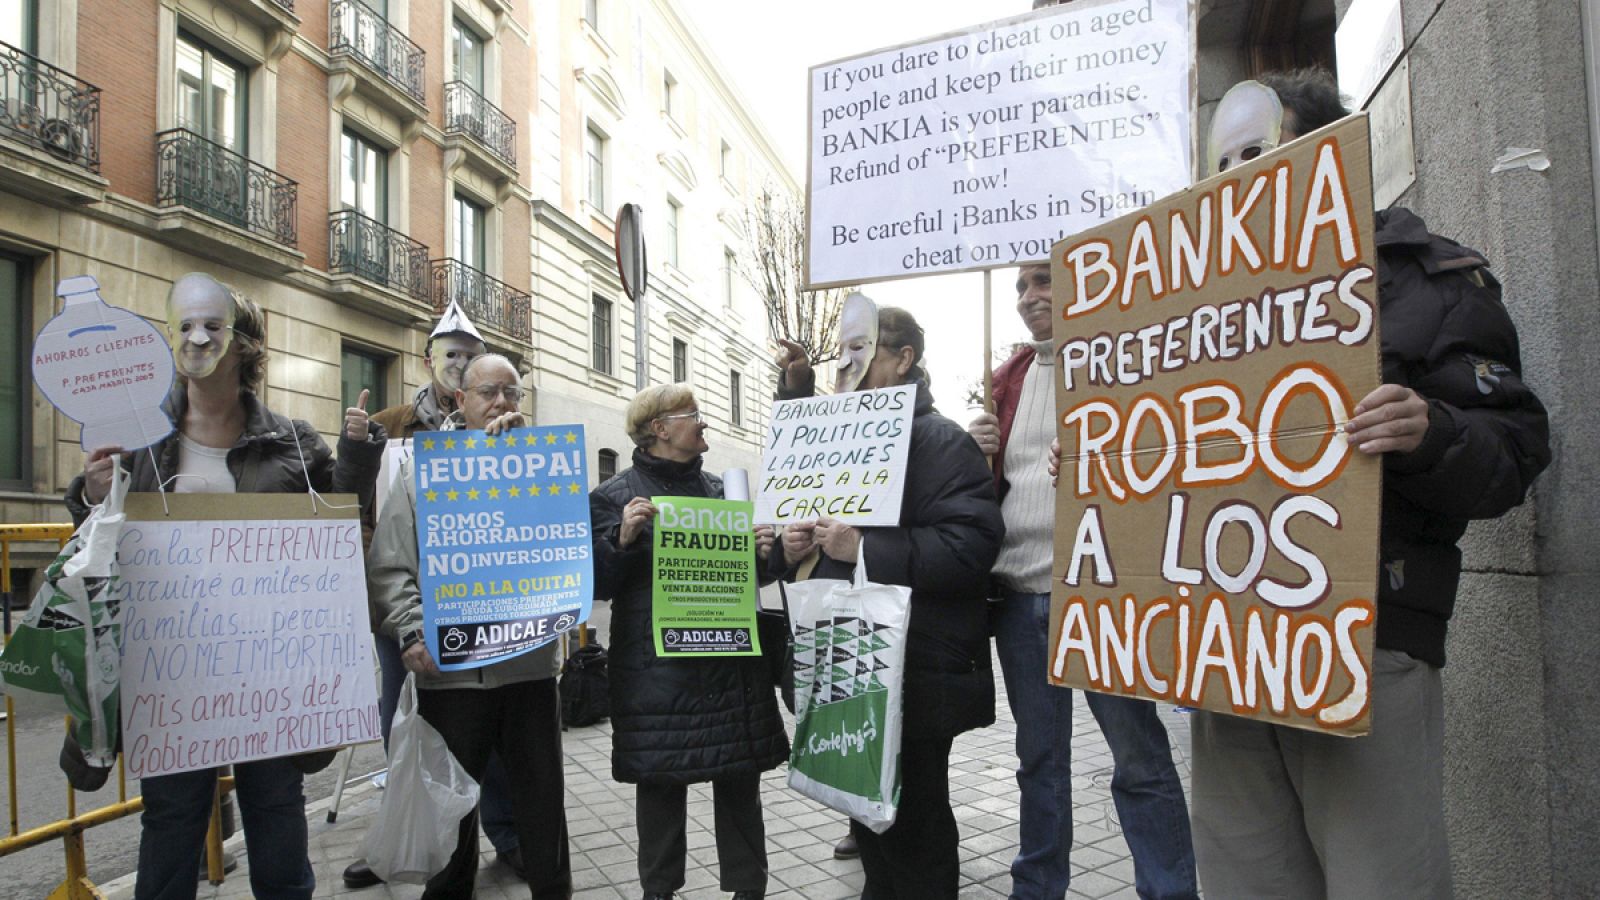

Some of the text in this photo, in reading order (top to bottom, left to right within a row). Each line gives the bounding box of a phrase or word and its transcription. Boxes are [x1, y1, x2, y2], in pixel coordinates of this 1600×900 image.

[822, 3, 1154, 92] If you dare to cheat on aged
[822, 40, 1168, 128] people and keep their money
[821, 82, 1149, 157] BANKIA is your paradise.
[829, 152, 900, 185] Refund
[906, 148, 932, 171] of
[952, 168, 1009, 195] now!
[831, 184, 1155, 247] Be careful ¡Banks in Spain
[1063, 136, 1361, 320] BANKIA
[901, 240, 964, 269] cheat
[970, 242, 1000, 261] on
[1060, 265, 1375, 391] PREFERENTES
[36, 333, 155, 365] AHORROS CLIENTES
[72, 385, 97, 395] CAJA
[100, 378, 132, 389] MADRID
[75, 362, 155, 385] PREFERENTES
[775, 391, 907, 421] BANQUEROS
[770, 417, 904, 449] Y POLITICOS
[1062, 363, 1353, 503] ROBO
[420, 450, 582, 489] ¡EUROPA!
[767, 443, 895, 472] LADRONES
[836, 471, 850, 486] A
[862, 469, 889, 485] LA
[427, 511, 505, 532] SOMOS
[659, 502, 749, 532] Bankia
[776, 494, 873, 519] CARCEL
[117, 525, 357, 566] Con las PREFERENTES
[425, 522, 588, 547] AHORRADORES
[660, 531, 749, 552] FRAUDE!
[427, 545, 589, 577] NO INVERSORES
[658, 557, 749, 570] PARTICIPACIONES
[1064, 492, 1342, 611] A LOS
[116, 565, 340, 602] arruiné a miles de
[435, 572, 581, 602] ¡NO A LA QUITA!
[658, 569, 749, 583] PREFERENTES
[662, 584, 745, 594] VENTA DE ACCIONES
[438, 597, 519, 610] PARTICIPACIONES
[461, 607, 493, 616] DEUDA
[462, 612, 508, 622] PRODUCTOS
[474, 618, 548, 646] ADICAE
[682, 630, 733, 642] ADICAE
[141, 643, 187, 683] NO
[194, 641, 229, 678] ME
[126, 674, 341, 731] Mis amigos del
[129, 732, 240, 778] Gobierno
[244, 731, 269, 757] me
